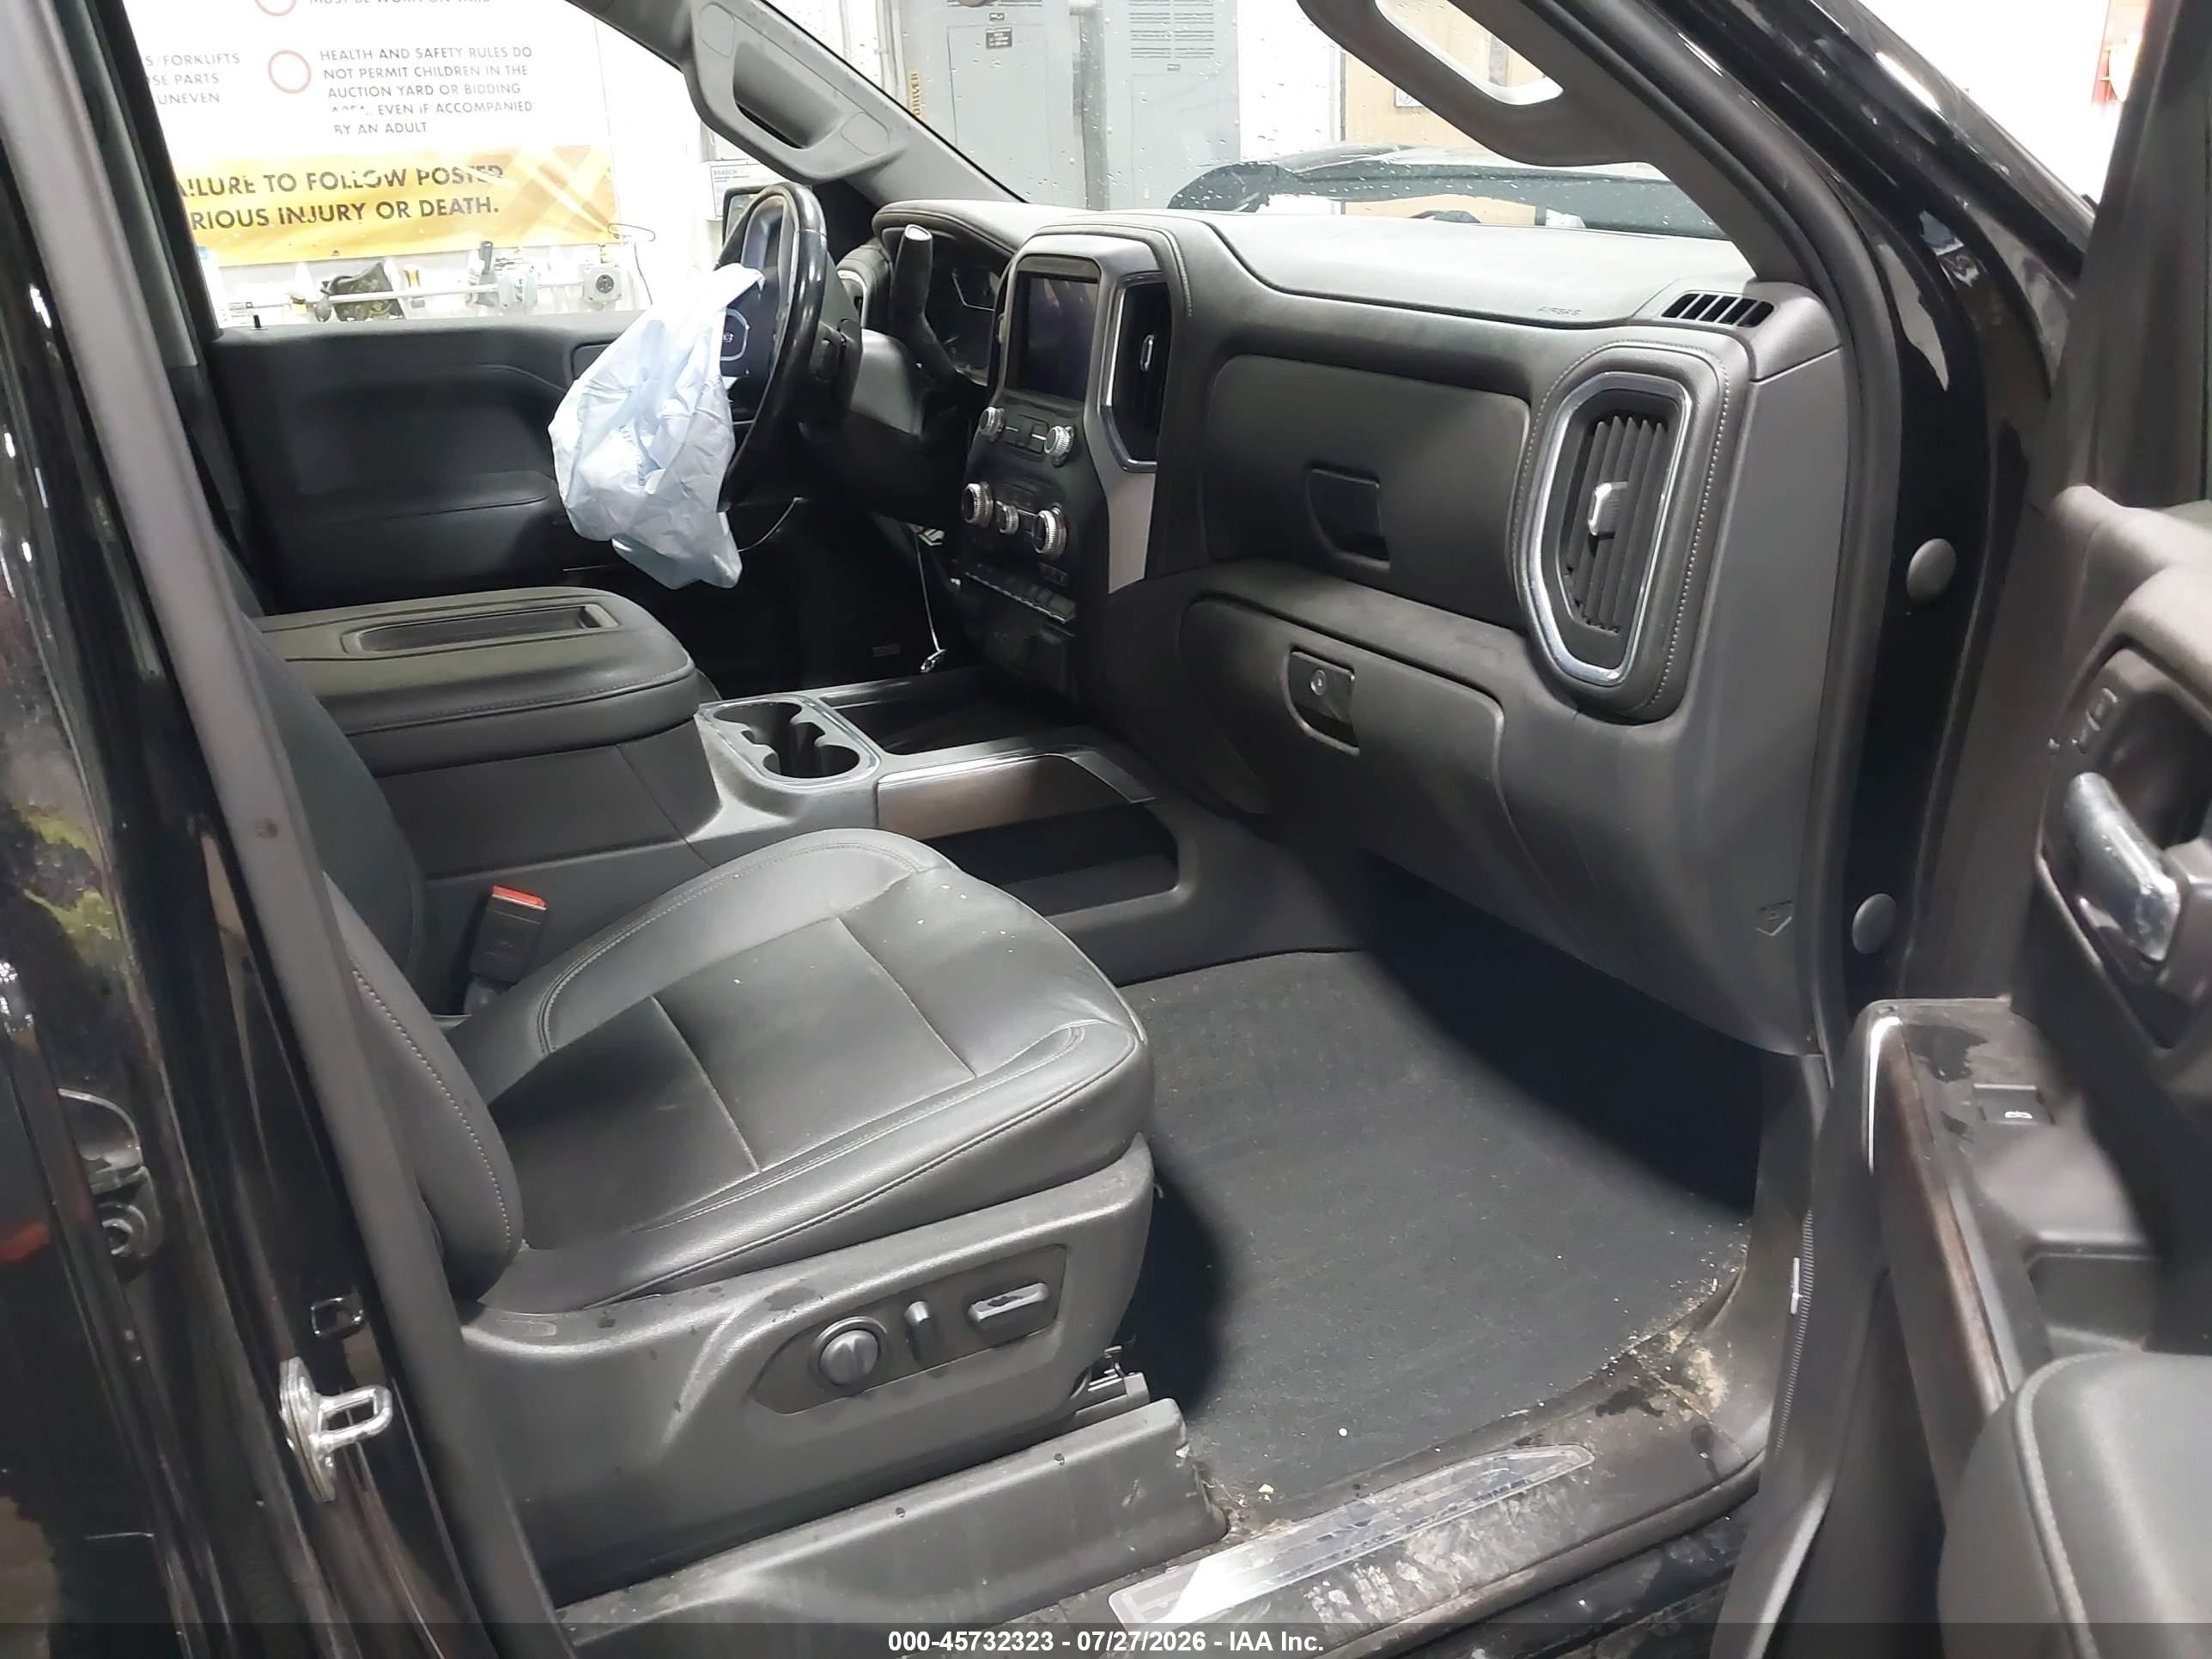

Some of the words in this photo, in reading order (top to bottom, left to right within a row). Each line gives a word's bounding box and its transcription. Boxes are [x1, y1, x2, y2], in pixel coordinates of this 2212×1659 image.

[320, 49, 373, 61] HEALTH
[379, 48, 410, 59] AND
[415, 47, 463, 58] SAFETY
[469, 46, 508, 58] RULES
[514, 46, 532, 58] DO
[174, 73, 220, 85] PARTS
[324, 68, 353, 80] NOT
[359, 67, 409, 79] PERMIT
[414, 65, 480, 78] CHILDREN
[485, 65, 501, 76] IN
[505, 64, 528, 76] THE
[328, 85, 392, 99] AUCTION
[397, 84, 434, 96] YARD
[439, 84, 459, 95] OR
[465, 82, 521, 94] BIDDING
[158, 93, 220, 105] UNEVEN
[378, 104, 414, 116] EVEN
[419, 103, 429, 114] IF
[435, 101, 532, 113] ACCOMPANIED
[358, 124, 379, 135] AN
[385, 122, 427, 133] ADULT
[263, 173, 297, 193] TO
[306, 168, 406, 191] FOLLOW
[277, 203, 366, 225] INJURY
[376, 201, 411, 219] OR
[419, 197, 499, 217] DEATH.
